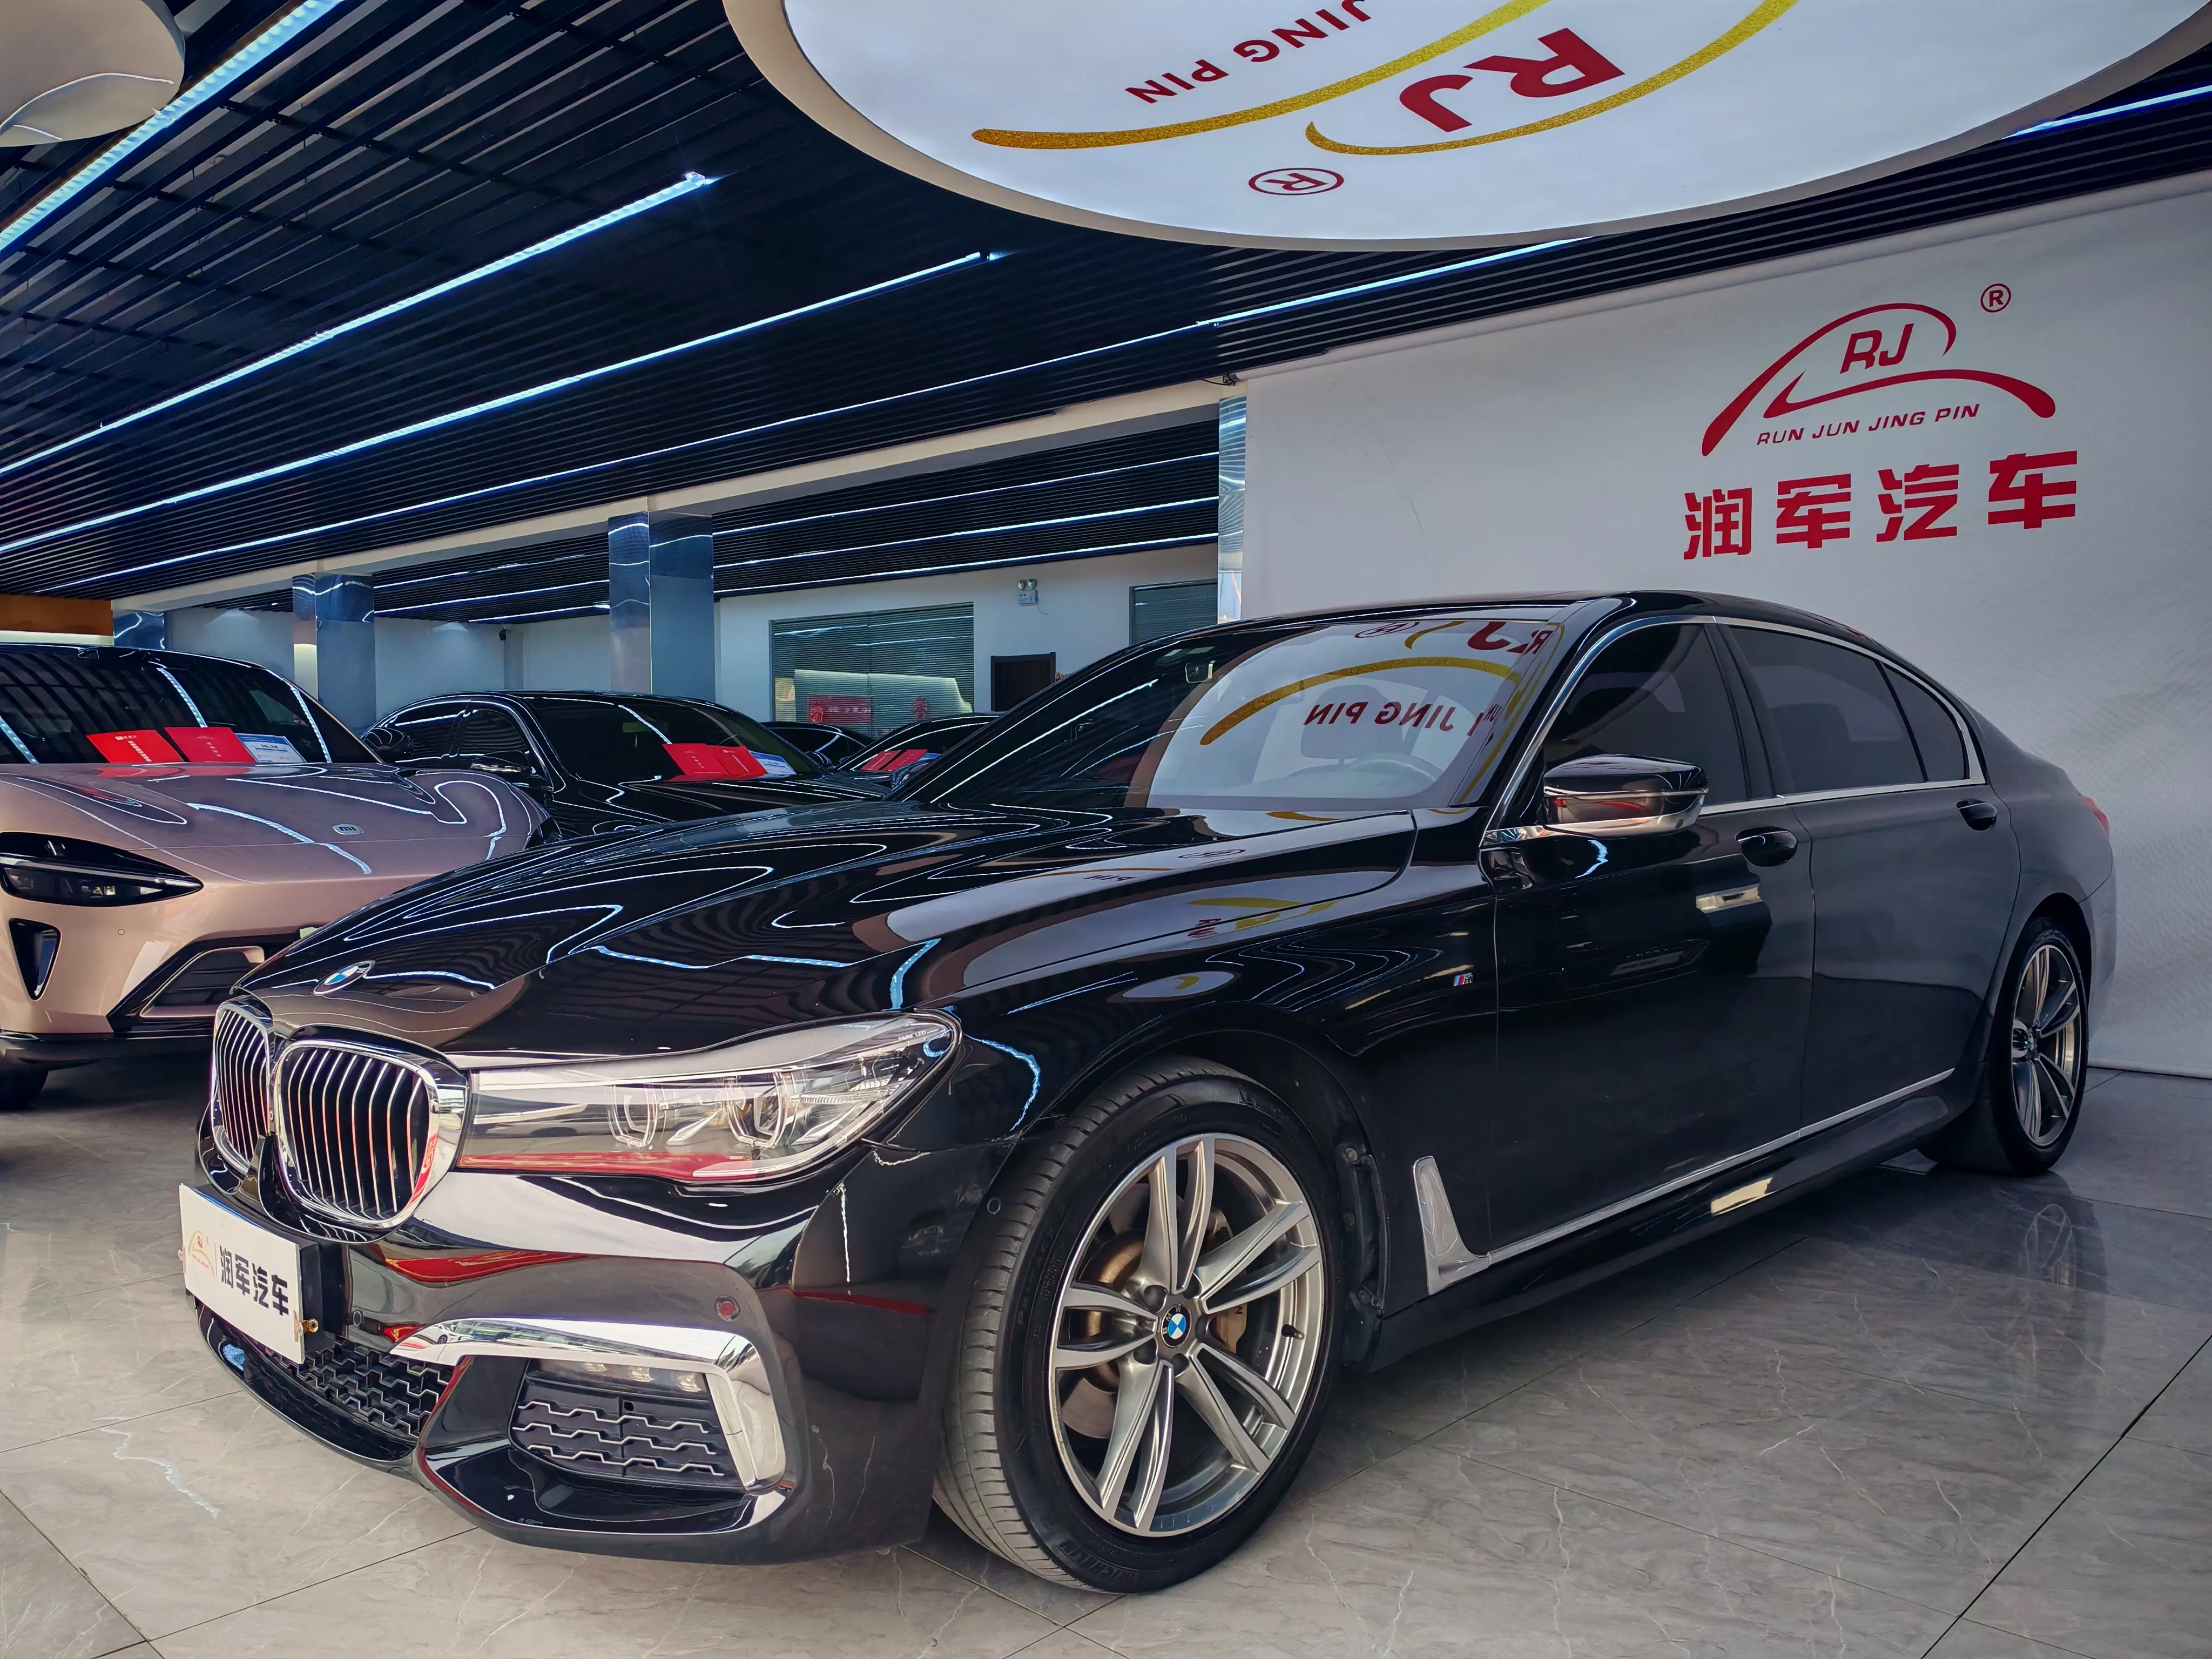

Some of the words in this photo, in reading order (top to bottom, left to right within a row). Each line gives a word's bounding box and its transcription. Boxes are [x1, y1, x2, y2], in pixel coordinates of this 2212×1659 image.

[1233, 0, 1372, 63] JING
[1124, 59, 1230, 104] PIN
[1399, 28, 1624, 133] RJ
[1839, 323, 1913, 374] RJ
[1757, 428, 1805, 446] RUN
[1811, 420, 1859, 439] JUN
[1868, 411, 1926, 433] JING
[1934, 403, 1980, 422] PIN
[1683, 450, 2078, 560] 润军汽车
[219, 1244, 289, 1316] 润军汽车
[1163, 1306, 1182, 1335] BMW
